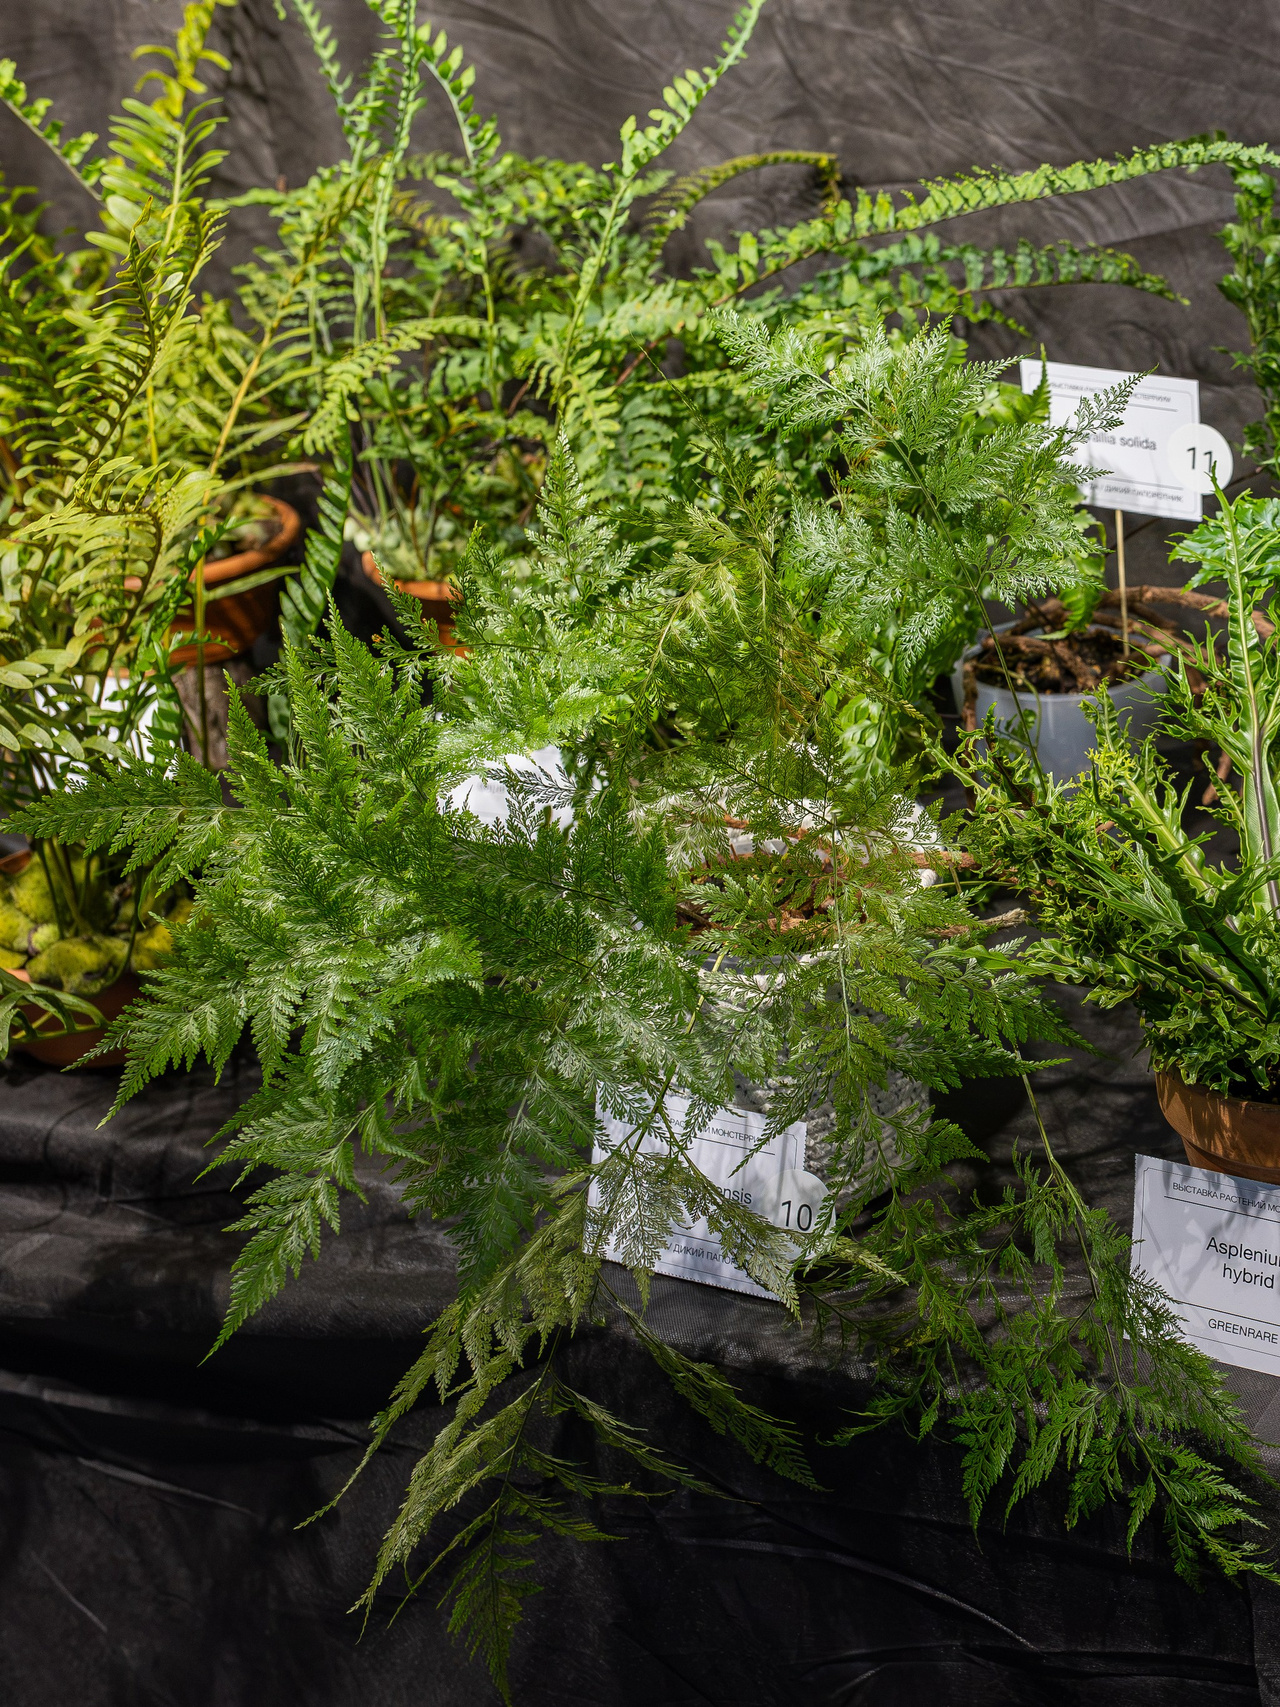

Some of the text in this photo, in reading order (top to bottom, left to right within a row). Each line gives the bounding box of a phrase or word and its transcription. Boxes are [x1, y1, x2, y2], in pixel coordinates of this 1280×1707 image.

[1119, 437, 1157, 451] solida
[1186, 446, 1213, 474] 11
[1172, 1182, 1219, 1200] ВЫСТАВКА
[1219, 1192, 1267, 1210] РАСТЕНИЙ
[781, 1200, 813, 1232] 10
[673, 1243, 706, 1259] ДИКИЙ
[1222, 1264, 1275, 1289] hybrid
[1208, 1318, 1279, 1344] GREENRARE
